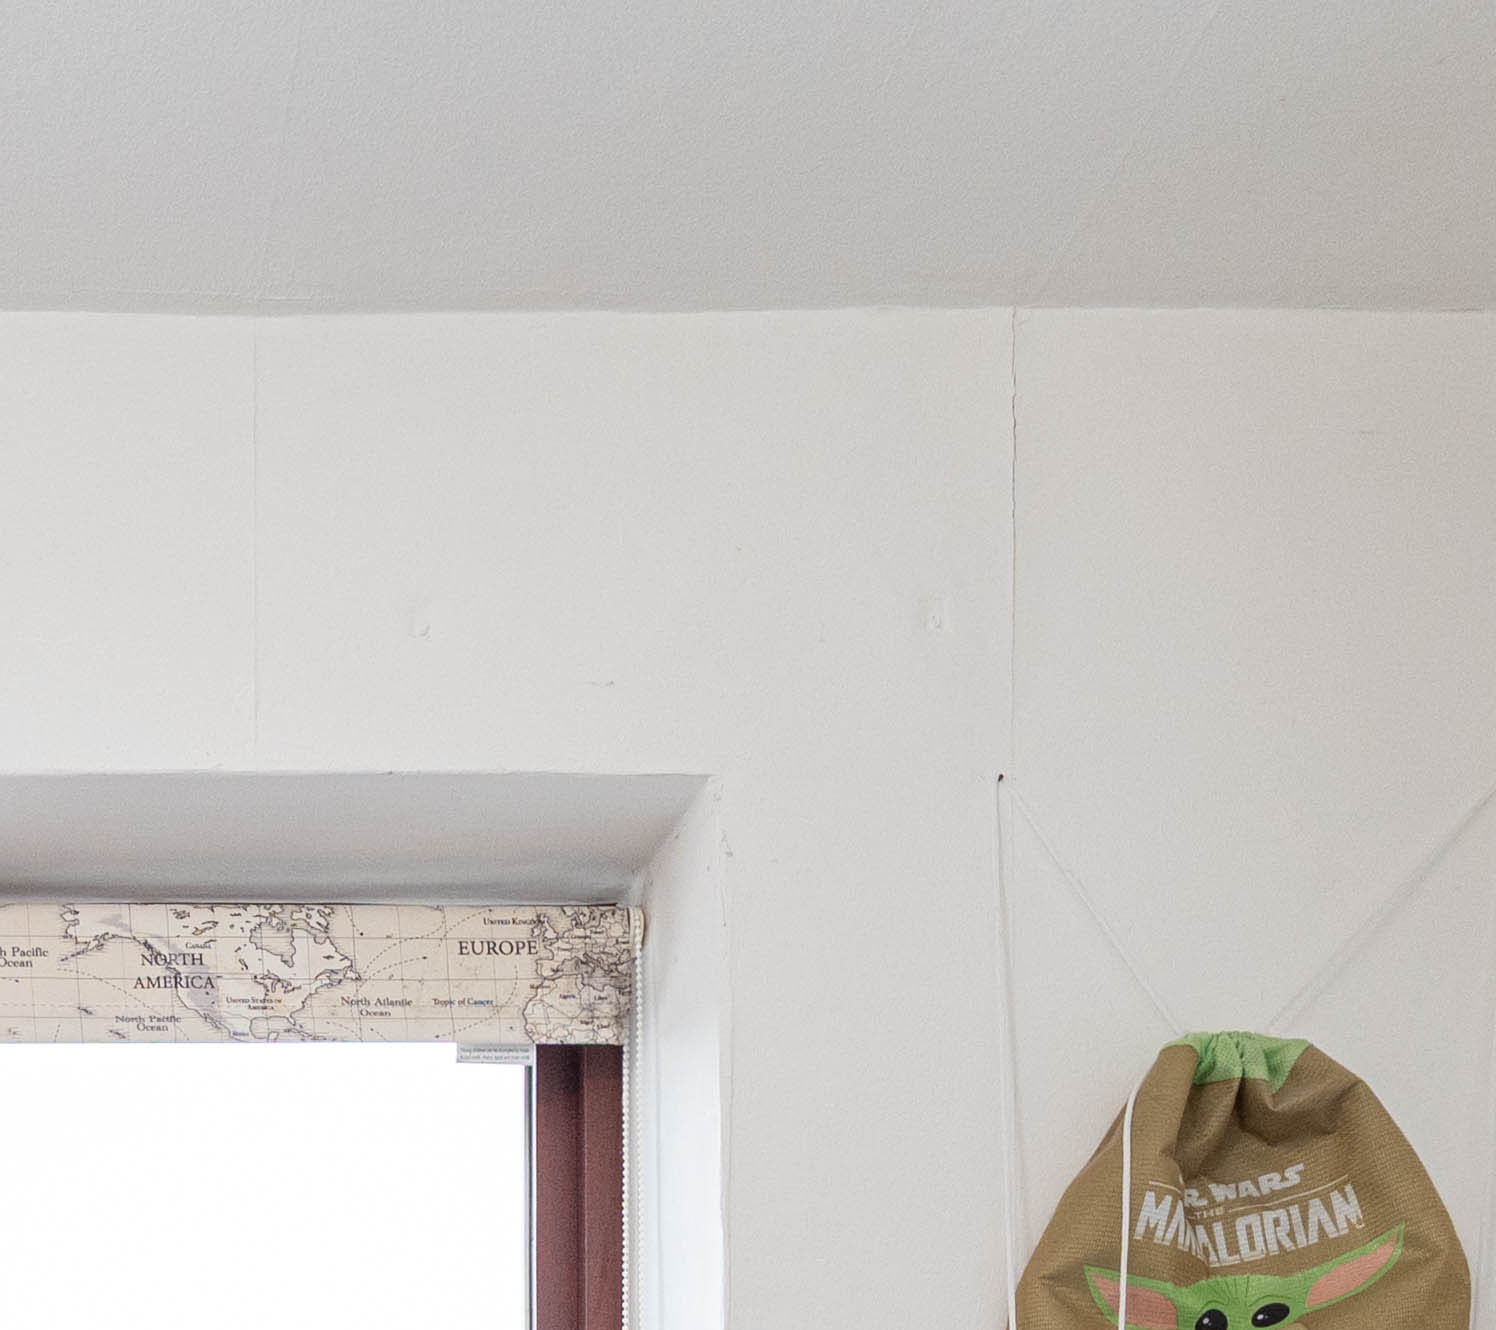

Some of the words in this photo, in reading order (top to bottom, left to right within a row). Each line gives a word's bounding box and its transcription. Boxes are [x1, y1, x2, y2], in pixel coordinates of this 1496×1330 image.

[11, 945, 49, 958] Pacific
[458, 940, 539, 957] EUROPE
[141, 953, 204, 967] NORTH
[134, 975, 216, 990] AMERICA
[340, 996, 371, 1007] North
[374, 996, 414, 1007] Atlantic
[1208, 1163, 1305, 1203] WARS
